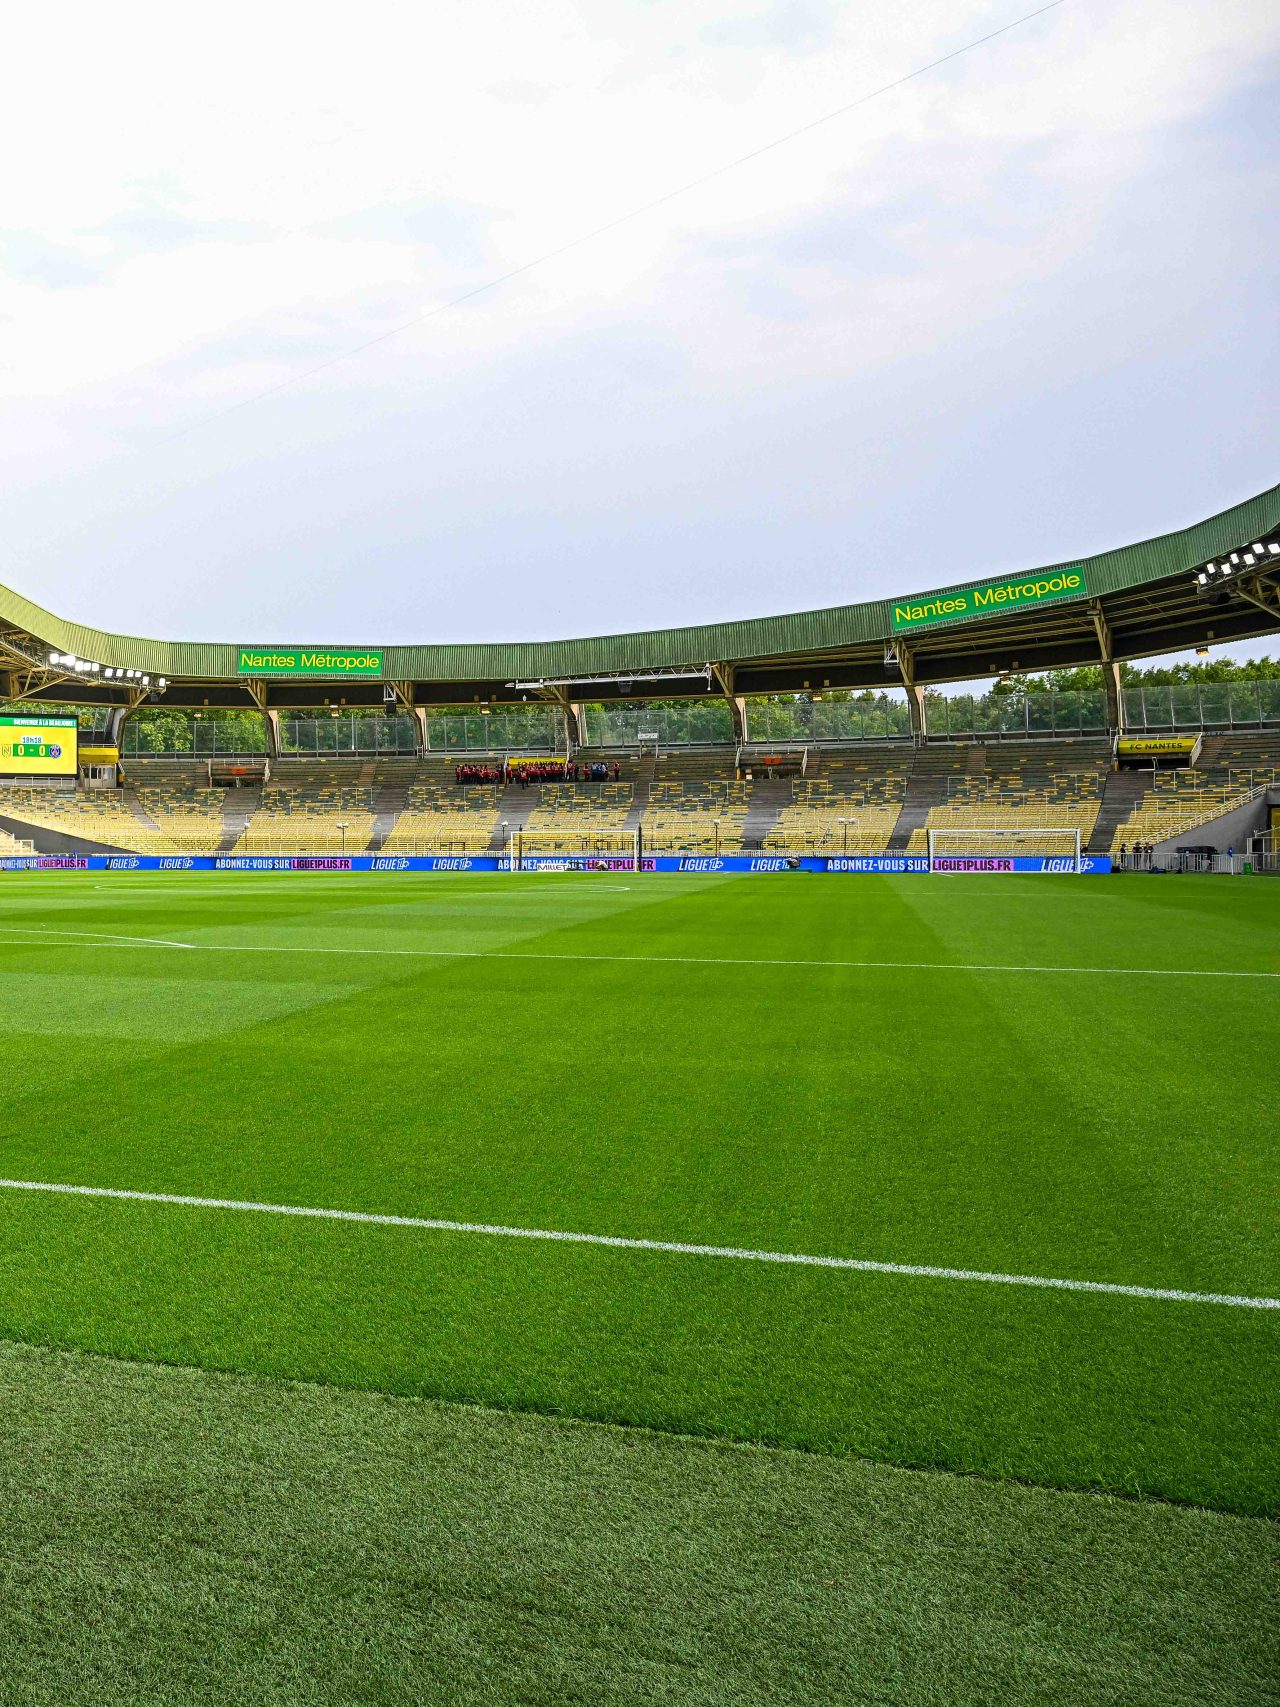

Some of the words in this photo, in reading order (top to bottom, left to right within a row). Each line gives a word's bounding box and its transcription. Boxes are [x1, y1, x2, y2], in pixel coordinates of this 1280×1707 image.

[894, 597, 967, 623] Nantes
[241, 653, 295, 667] Nantes
[22, 736, 42, 744] 18h18
[1145, 742, 1183, 750] NANTES
[216, 858, 273, 870] ABONNEZ-VOUS
[274, 858, 290, 869] SUR
[292, 858, 350, 870] LIGUE1PLUS.FR
[827, 858, 905, 871] ABONNEZ-VOUS
[907, 858, 929, 871] SUR
[933, 858, 1011, 872] LIGUE1PLUS.FR
